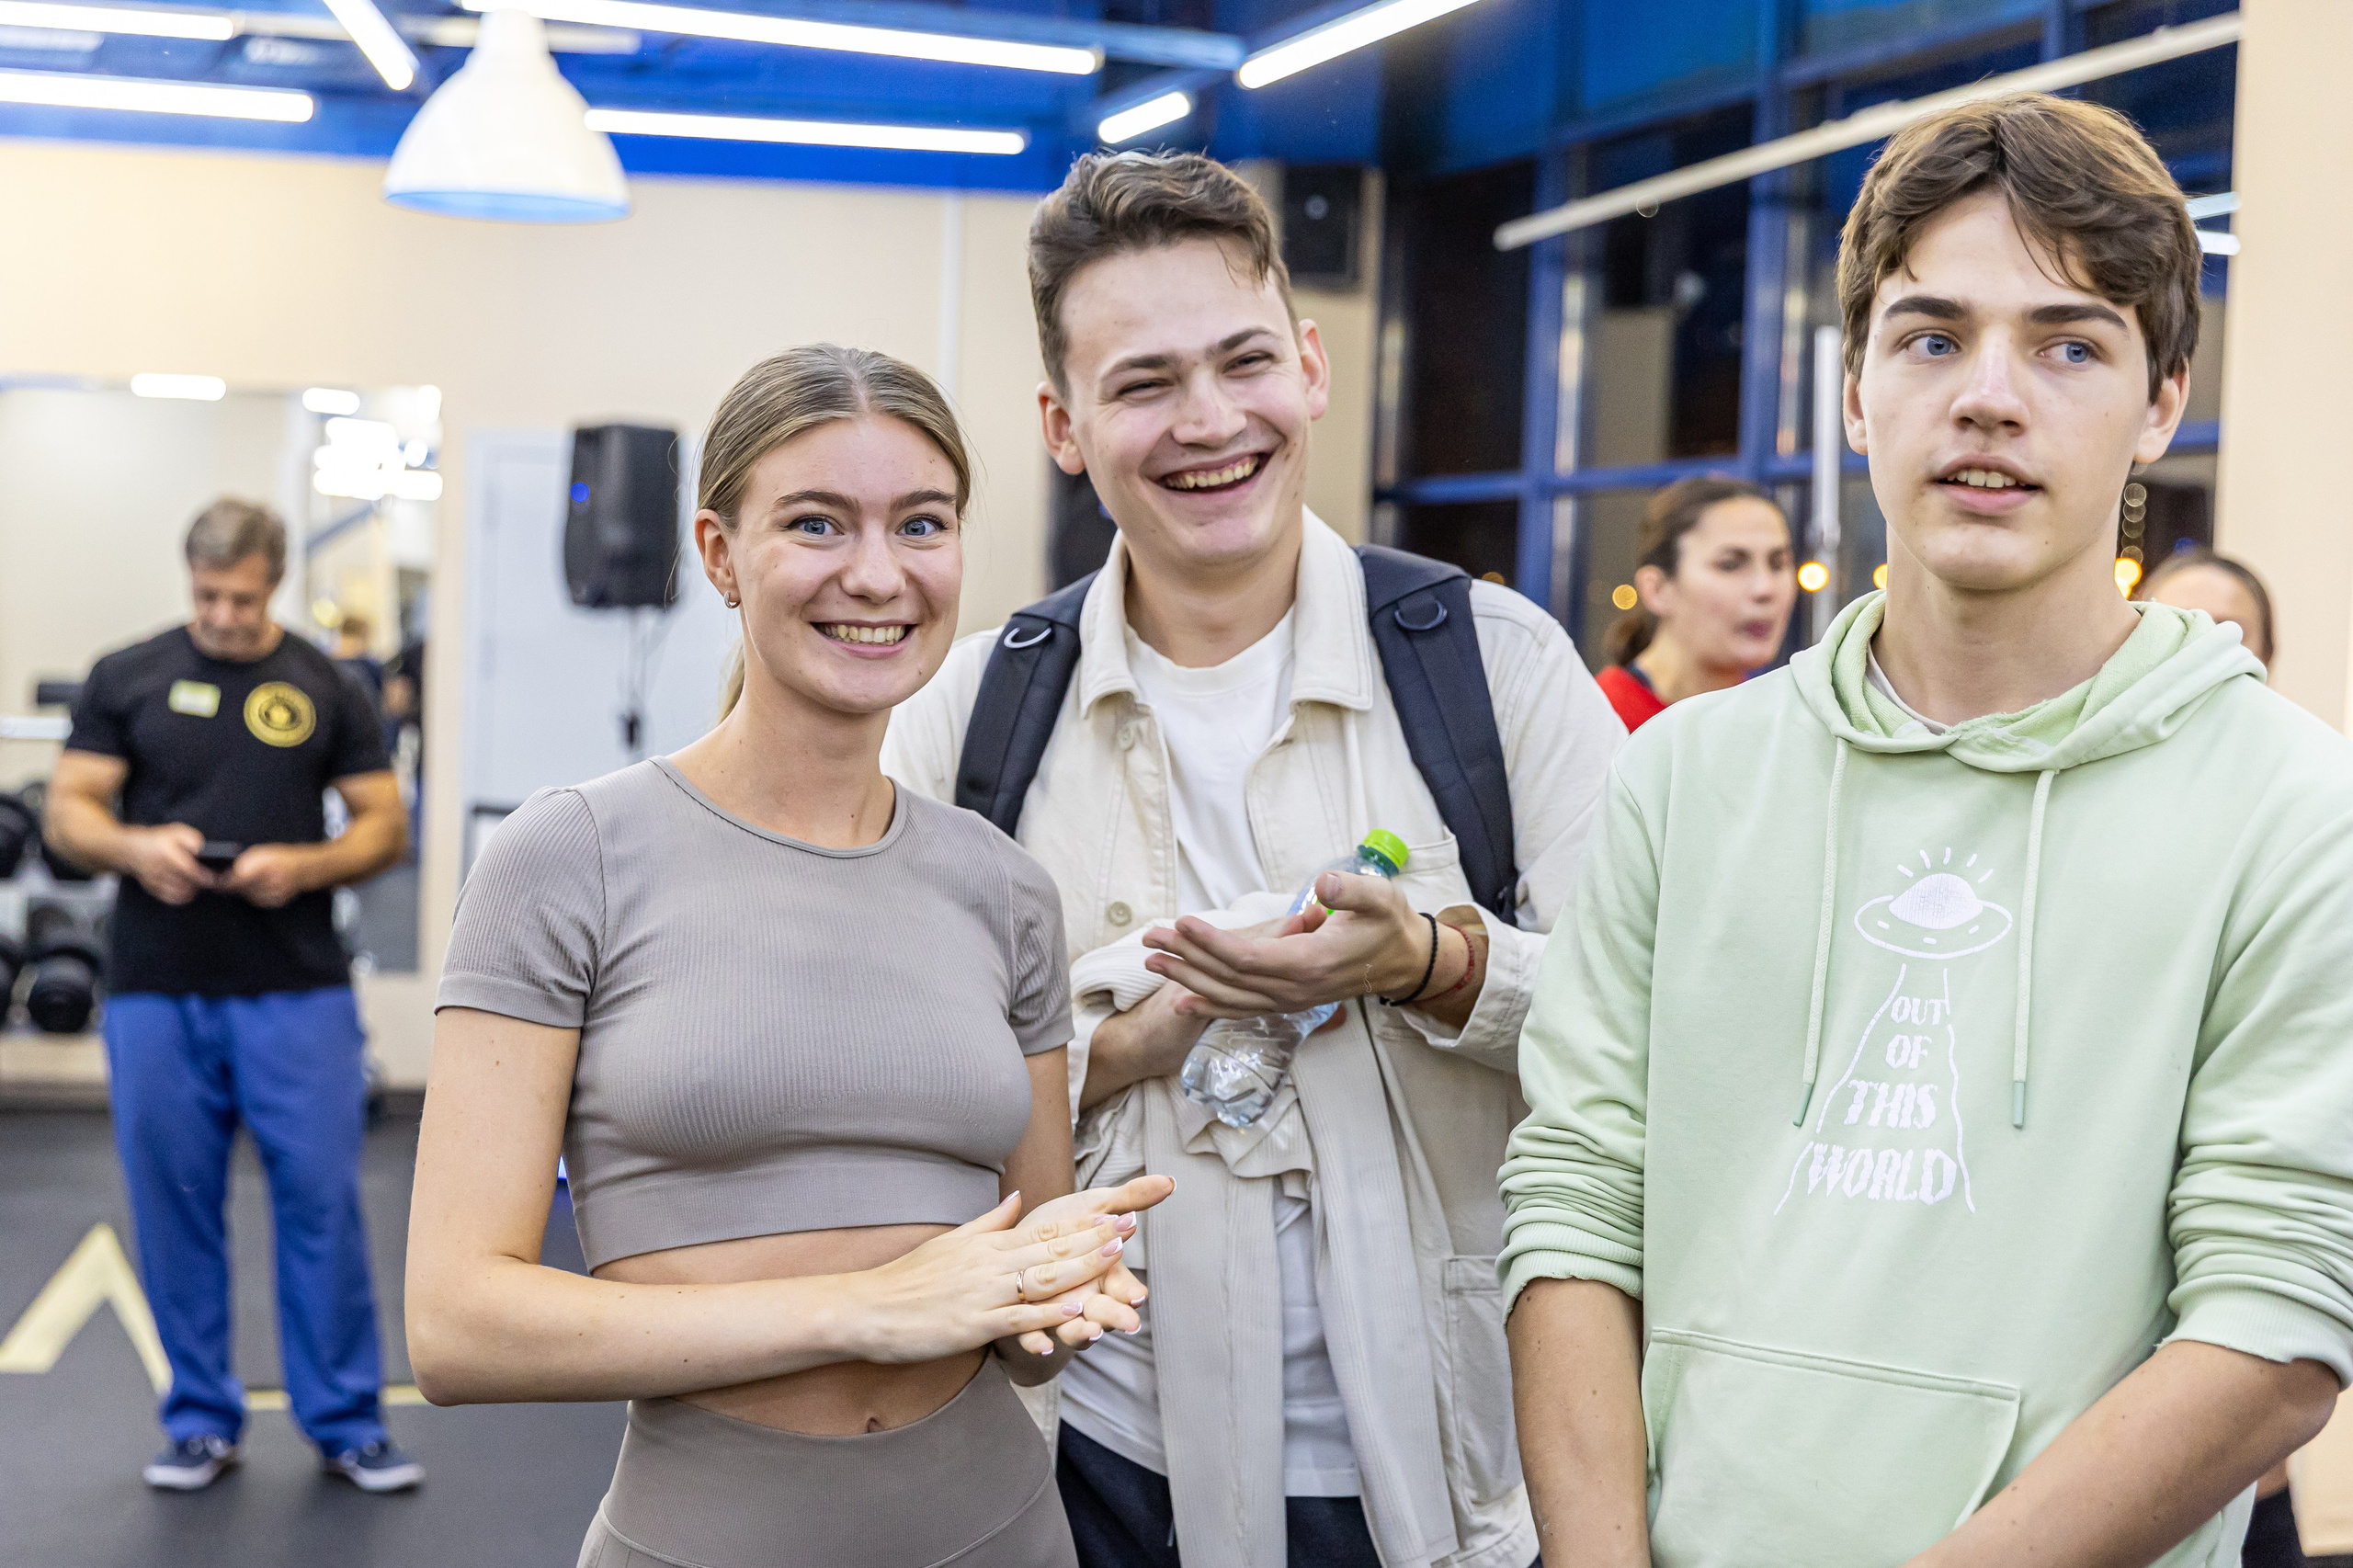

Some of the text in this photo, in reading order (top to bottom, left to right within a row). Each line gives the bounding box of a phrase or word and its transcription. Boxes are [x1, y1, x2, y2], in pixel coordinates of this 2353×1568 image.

[1891, 996, 1946, 1026] OUT
[1886, 1035, 1932, 1070] OF
[1844, 1080, 1938, 1129] THIS
[1807, 1143, 1957, 1205] WORLD
